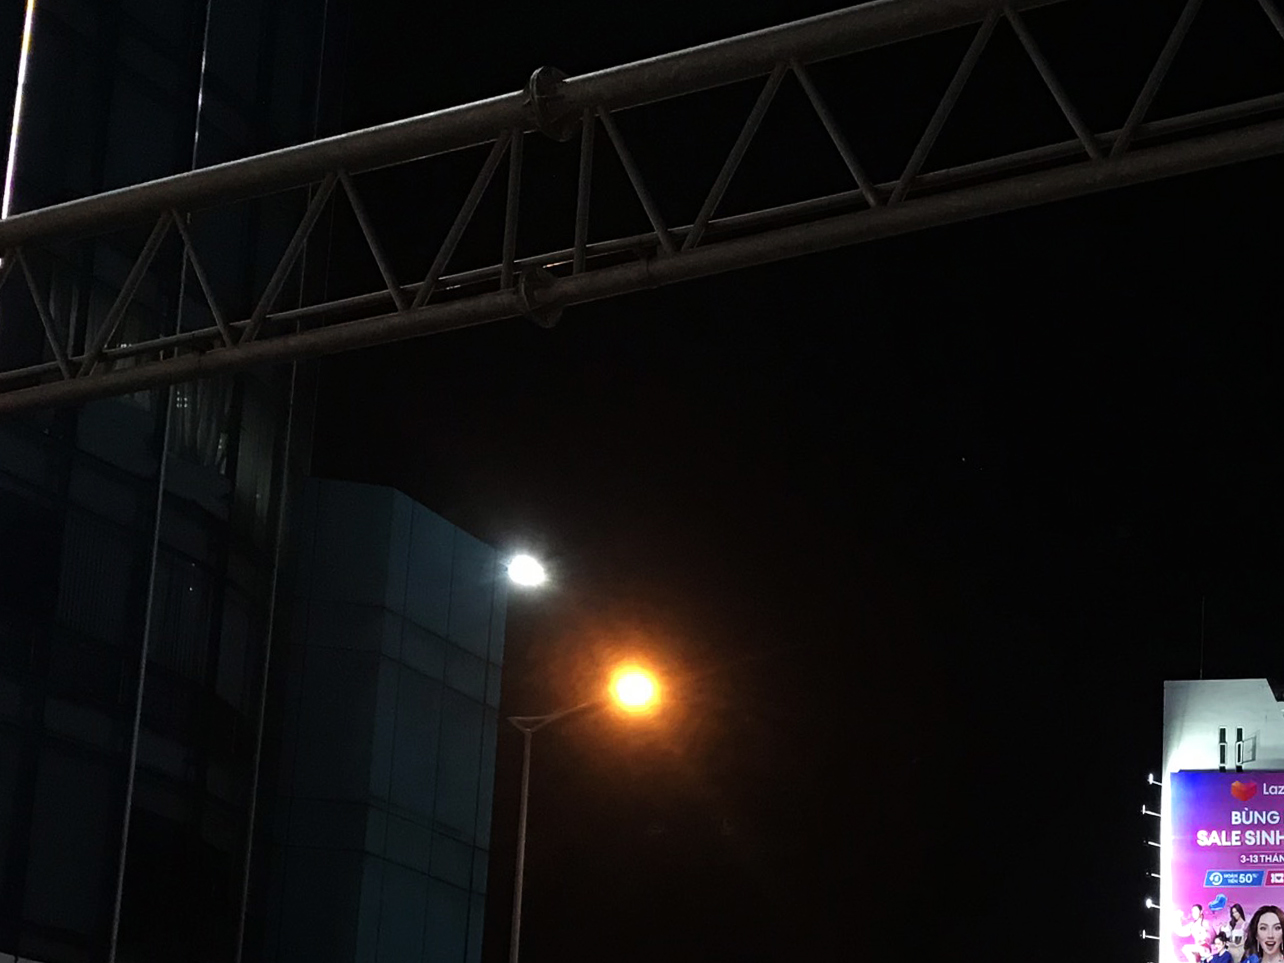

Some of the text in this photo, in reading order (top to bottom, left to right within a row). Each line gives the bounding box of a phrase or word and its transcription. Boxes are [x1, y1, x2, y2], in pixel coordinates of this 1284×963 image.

[1231, 807, 1280, 825] BÙNG
[1196, 830, 1242, 846] SALE
[1240, 854, 1259, 863] 3-13
